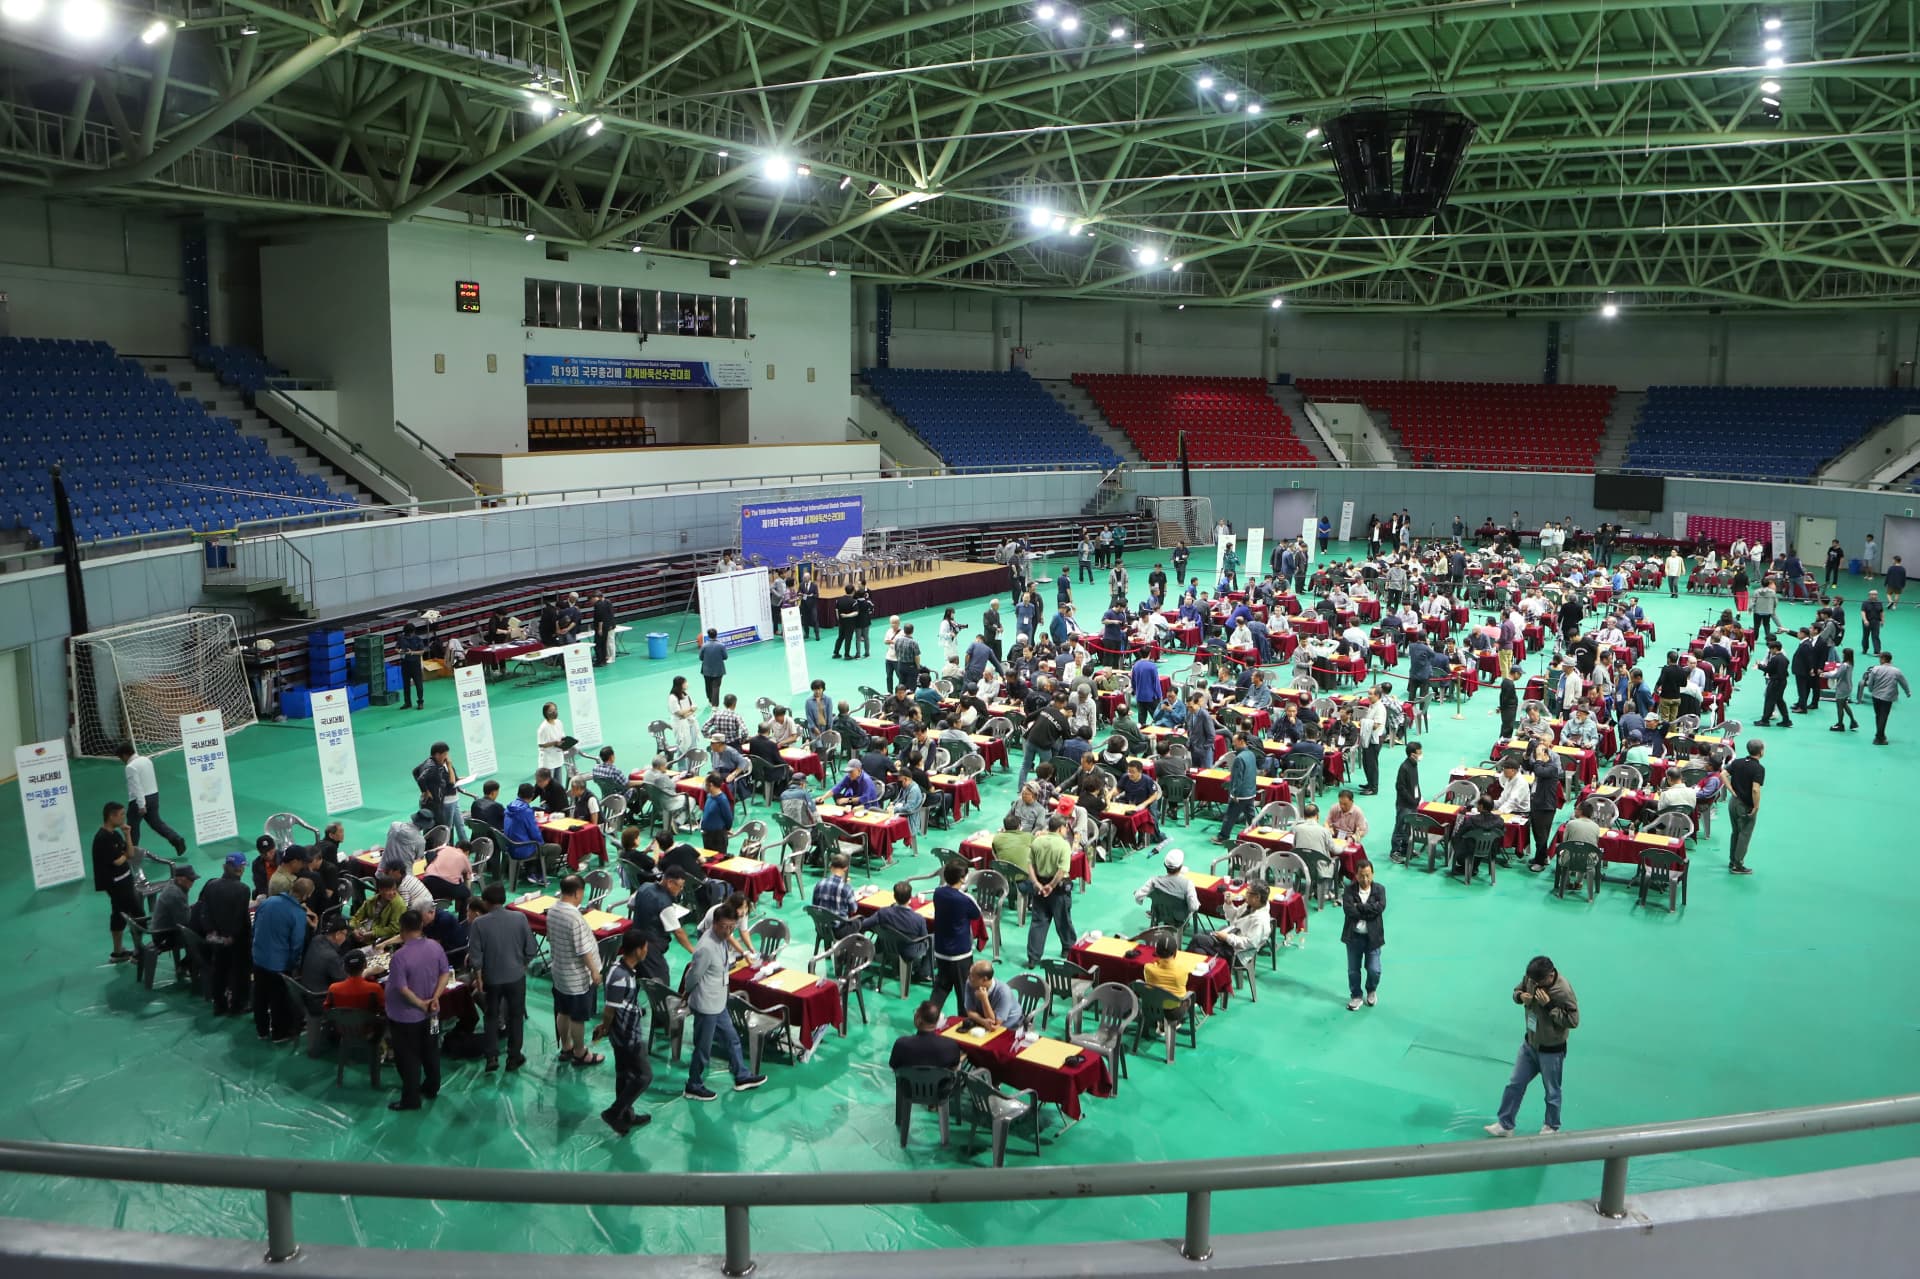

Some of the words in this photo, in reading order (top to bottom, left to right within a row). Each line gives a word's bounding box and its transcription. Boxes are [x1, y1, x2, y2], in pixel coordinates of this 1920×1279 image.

[551, 365, 579, 377] 제19회
[582, 366, 621, 379] 국무총리배
[624, 367, 691, 381] 세계바둑선수권대회
[191, 738, 219, 750] 국내대회
[188, 751, 225, 765] 전국동호인
[28, 770, 62, 784] 국내대회
[25, 785, 69, 801] 전국동호인
